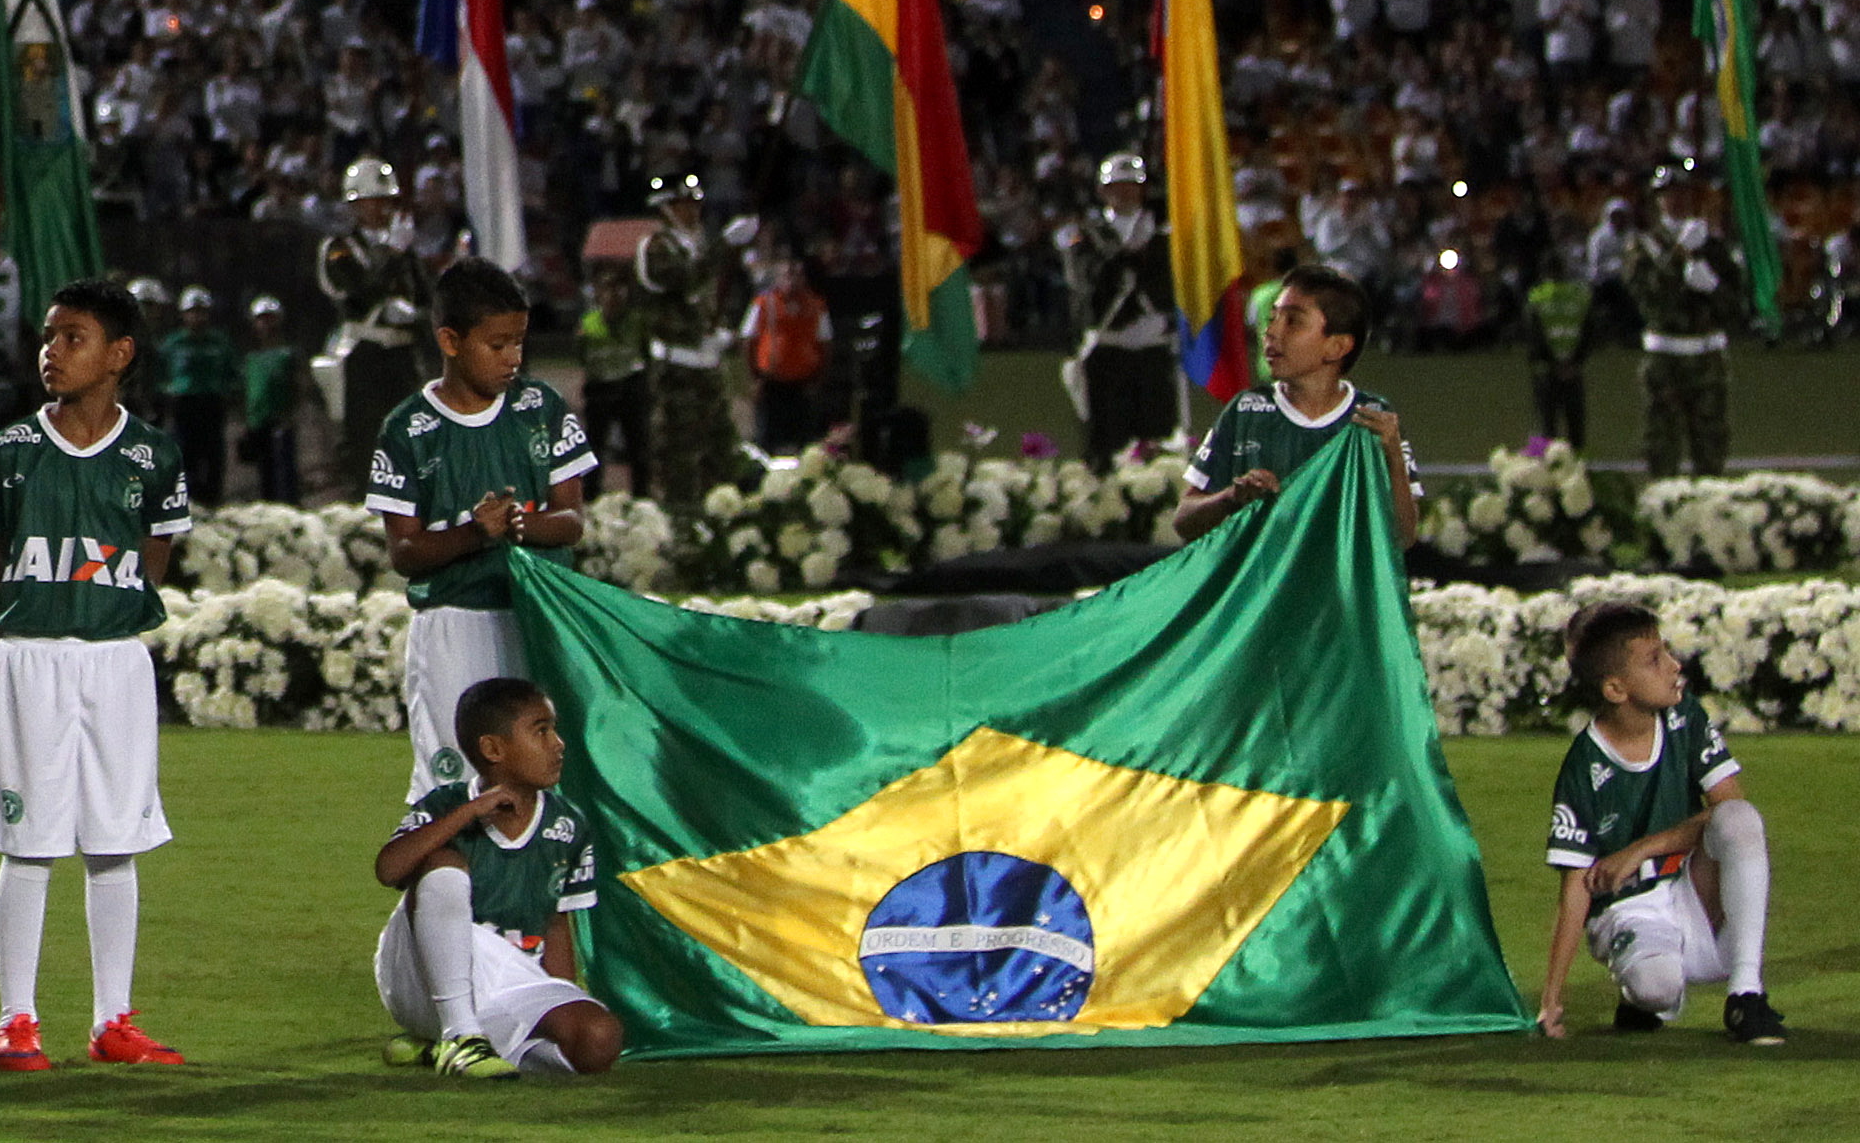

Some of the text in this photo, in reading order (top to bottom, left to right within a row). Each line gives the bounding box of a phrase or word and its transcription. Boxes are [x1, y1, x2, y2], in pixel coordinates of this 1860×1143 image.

[1, 537, 145, 592] AIXA
[865, 931, 937, 951] ORDEM
[950, 932, 963, 948] E
